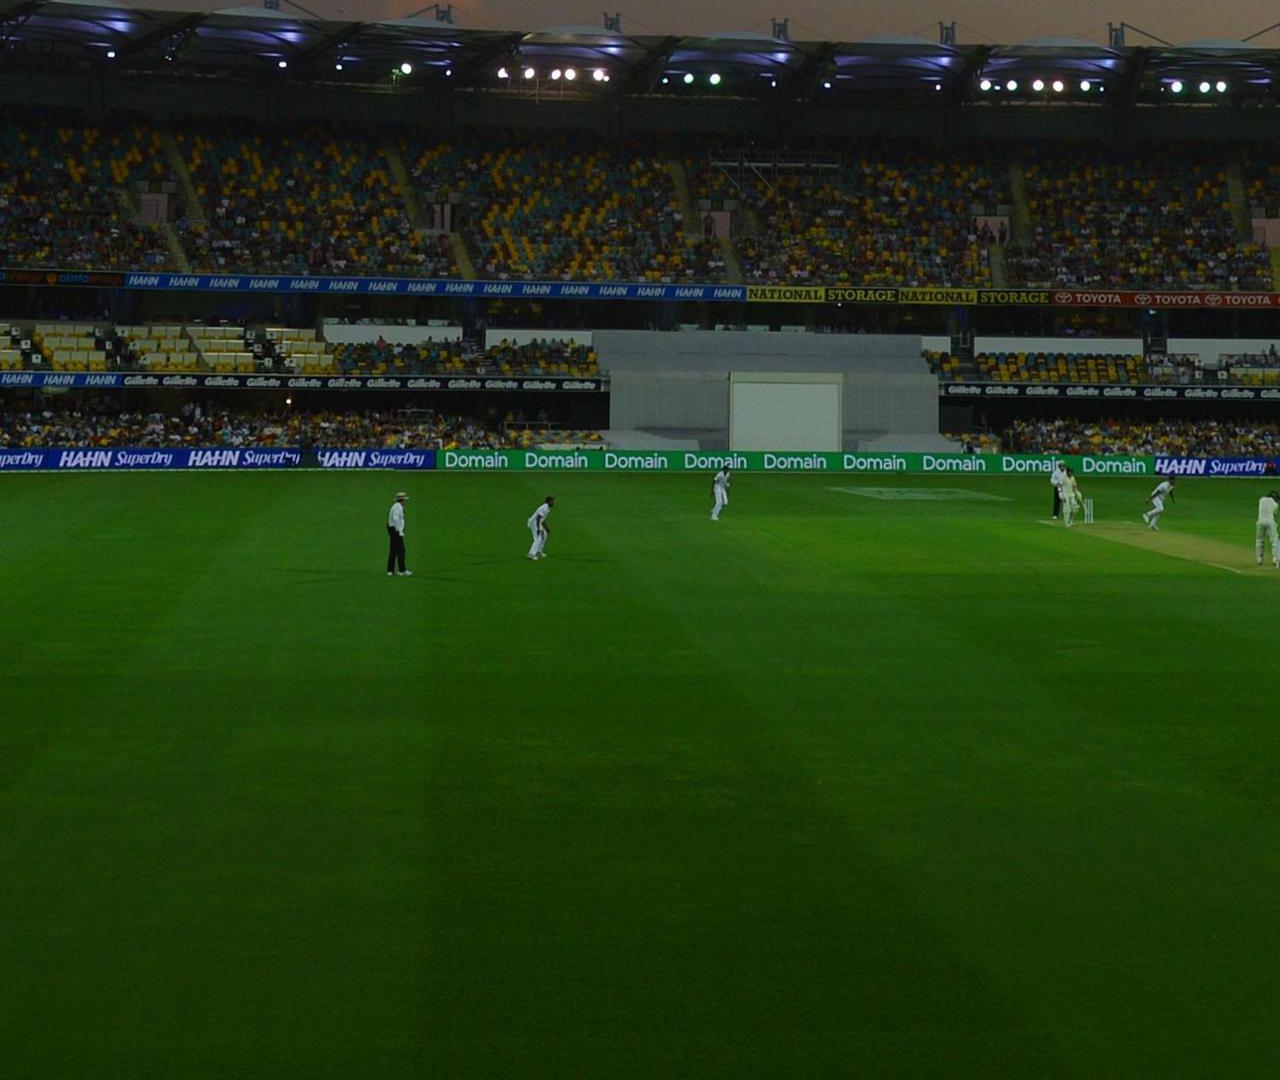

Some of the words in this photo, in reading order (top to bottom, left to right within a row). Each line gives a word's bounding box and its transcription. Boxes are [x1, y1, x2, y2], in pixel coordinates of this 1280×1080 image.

[129, 275, 159, 286] HAHN
[170, 276, 199, 287] HAHN
[210, 278, 239, 289] HAHN
[249, 279, 279, 289] HAHN
[290, 279, 319, 290] HAHN
[329, 280, 358, 291] HAHN
[369, 281, 397, 291] HAHN
[408, 282, 436, 292] HAHN
[446, 282, 473, 293] HAHN
[484, 283, 512, 294] HAHN
[523, 284, 550, 294] HAHN
[561, 284, 589, 295] HAHN
[600, 285, 627, 295] HAHN
[637, 286, 665, 296] HAHN
[675, 286, 704, 297] HAHN
[714, 287, 742, 298] HAHN
[748, 289, 821, 302] NATIONAL
[828, 290, 898, 302] STORAGE
[900, 291, 973, 303] NATIONAL
[980, 292, 1049, 305] STORAGE
[1075, 293, 1121, 304] TOYOTA
[1156, 294, 1201, 305] TOYOTA
[1225, 295, 1271, 306] TOYOTA
[2, 373, 32, 385] HAHN
[44, 374, 74, 385] HAHN
[85, 374, 115, 386] HAHN
[59, 451, 113, 468] HAHN
[114, 451, 172, 468] SuperDry
[187, 451, 240, 468] HAHN
[368, 451, 425, 468] SuperDry
[445, 452, 507, 469] Domain
[525, 452, 588, 469] Domain
[605, 453, 668, 469] Domain
[684, 453, 747, 470] Domain
[764, 454, 827, 470] Domain
[843, 455, 906, 471] Domain
[923, 456, 985, 472] Domain
[1082, 458, 1146, 473] Domain
[1155, 459, 1206, 474] HAHN
[1209, 460, 1267, 475] SuperDry
